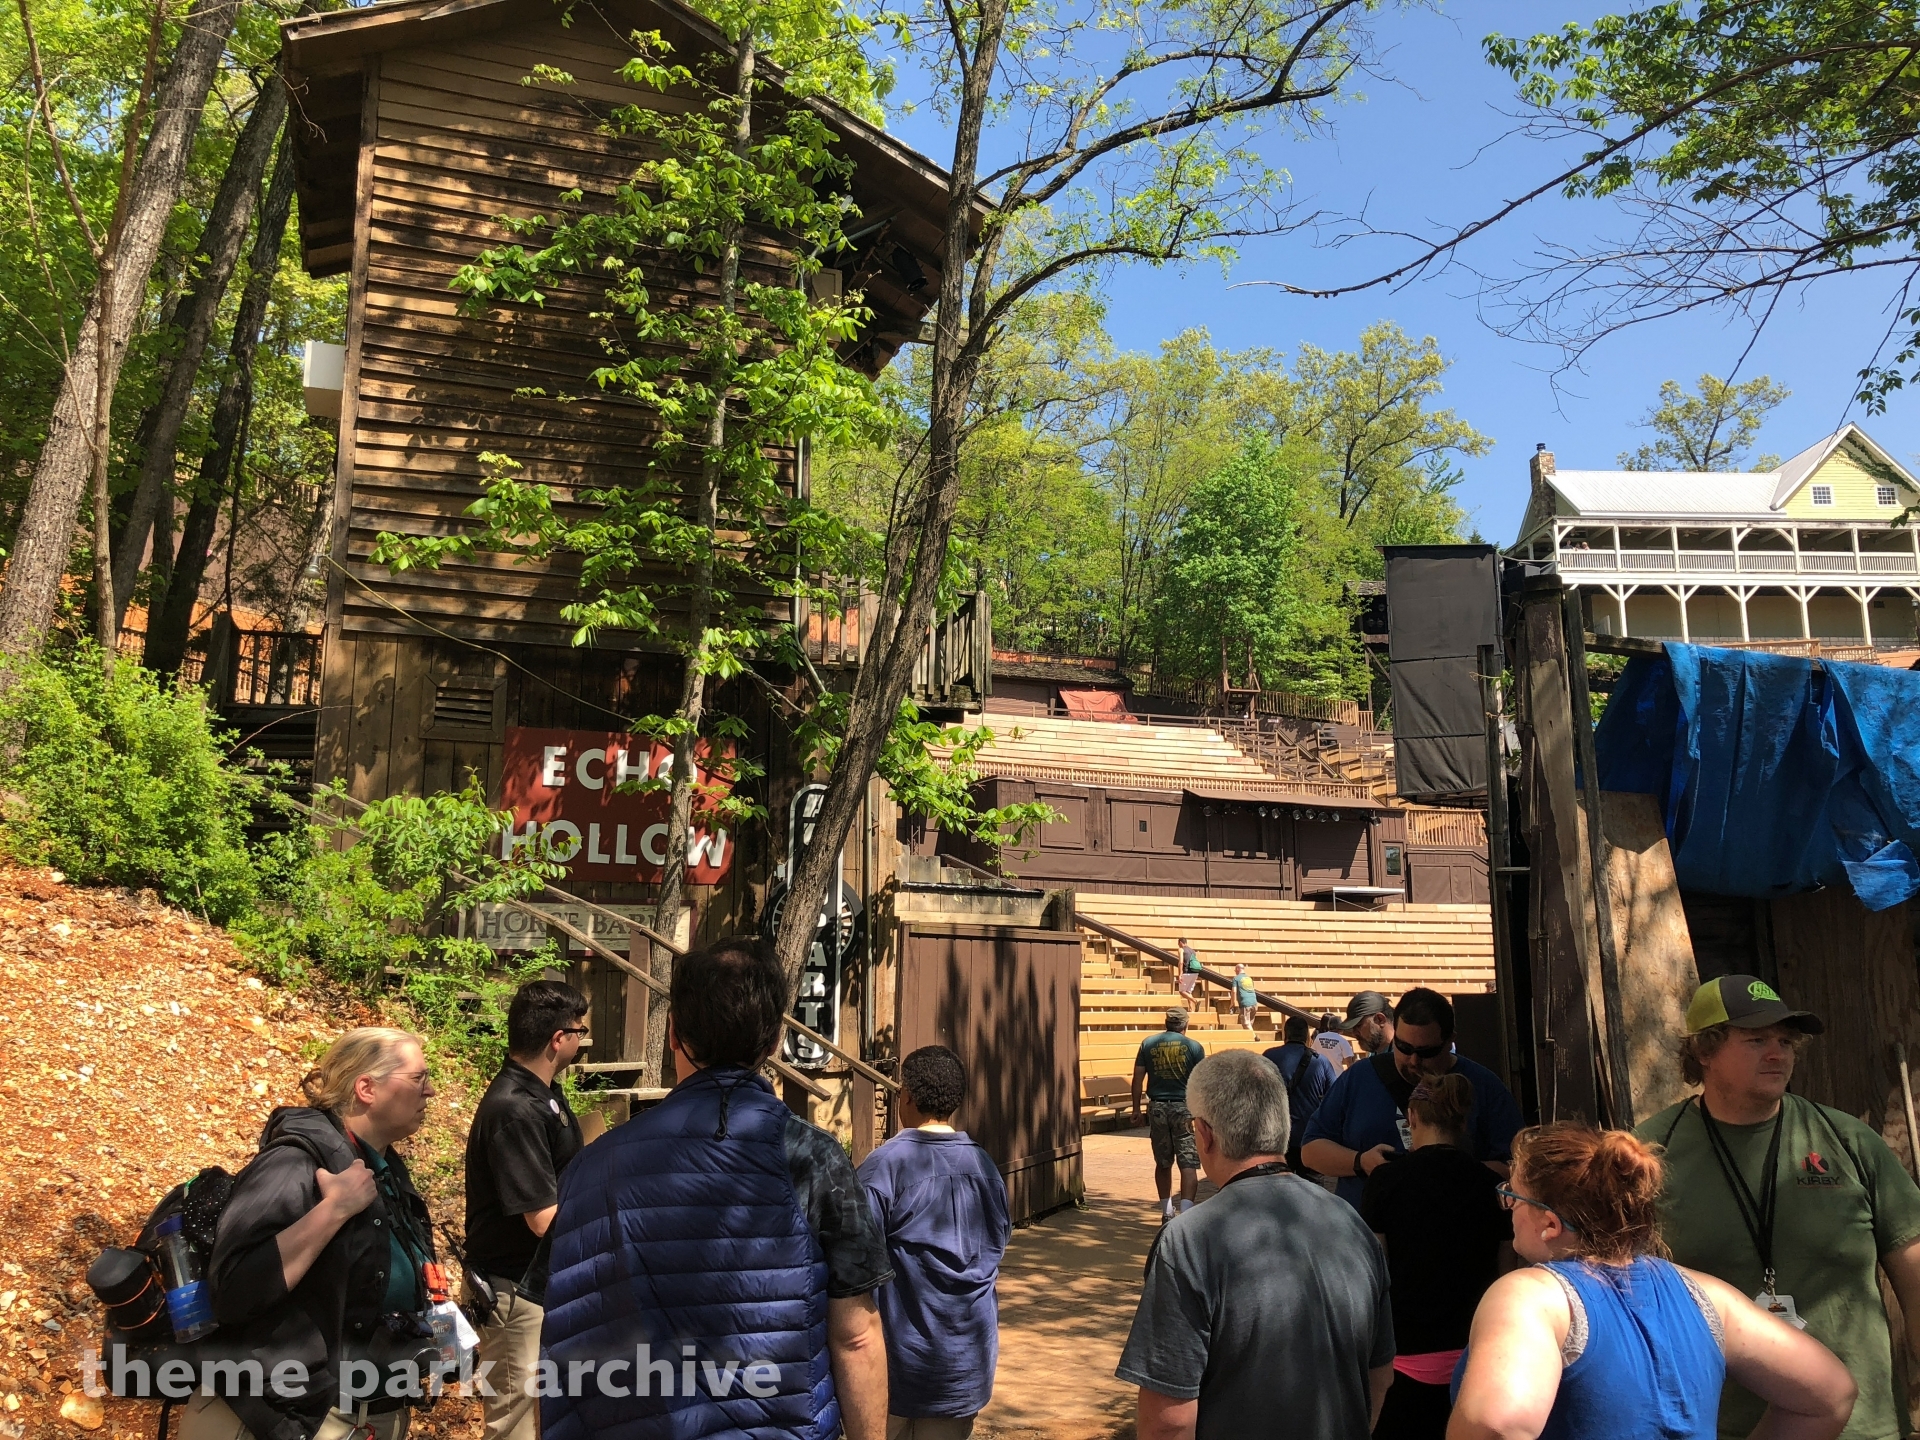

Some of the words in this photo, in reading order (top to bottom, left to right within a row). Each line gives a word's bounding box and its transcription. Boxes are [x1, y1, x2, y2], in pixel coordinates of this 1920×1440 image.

[501, 819, 728, 868] HOLLOW
[591, 912, 656, 935] BAR
[1796, 1176, 1839, 1185] KIRBY
